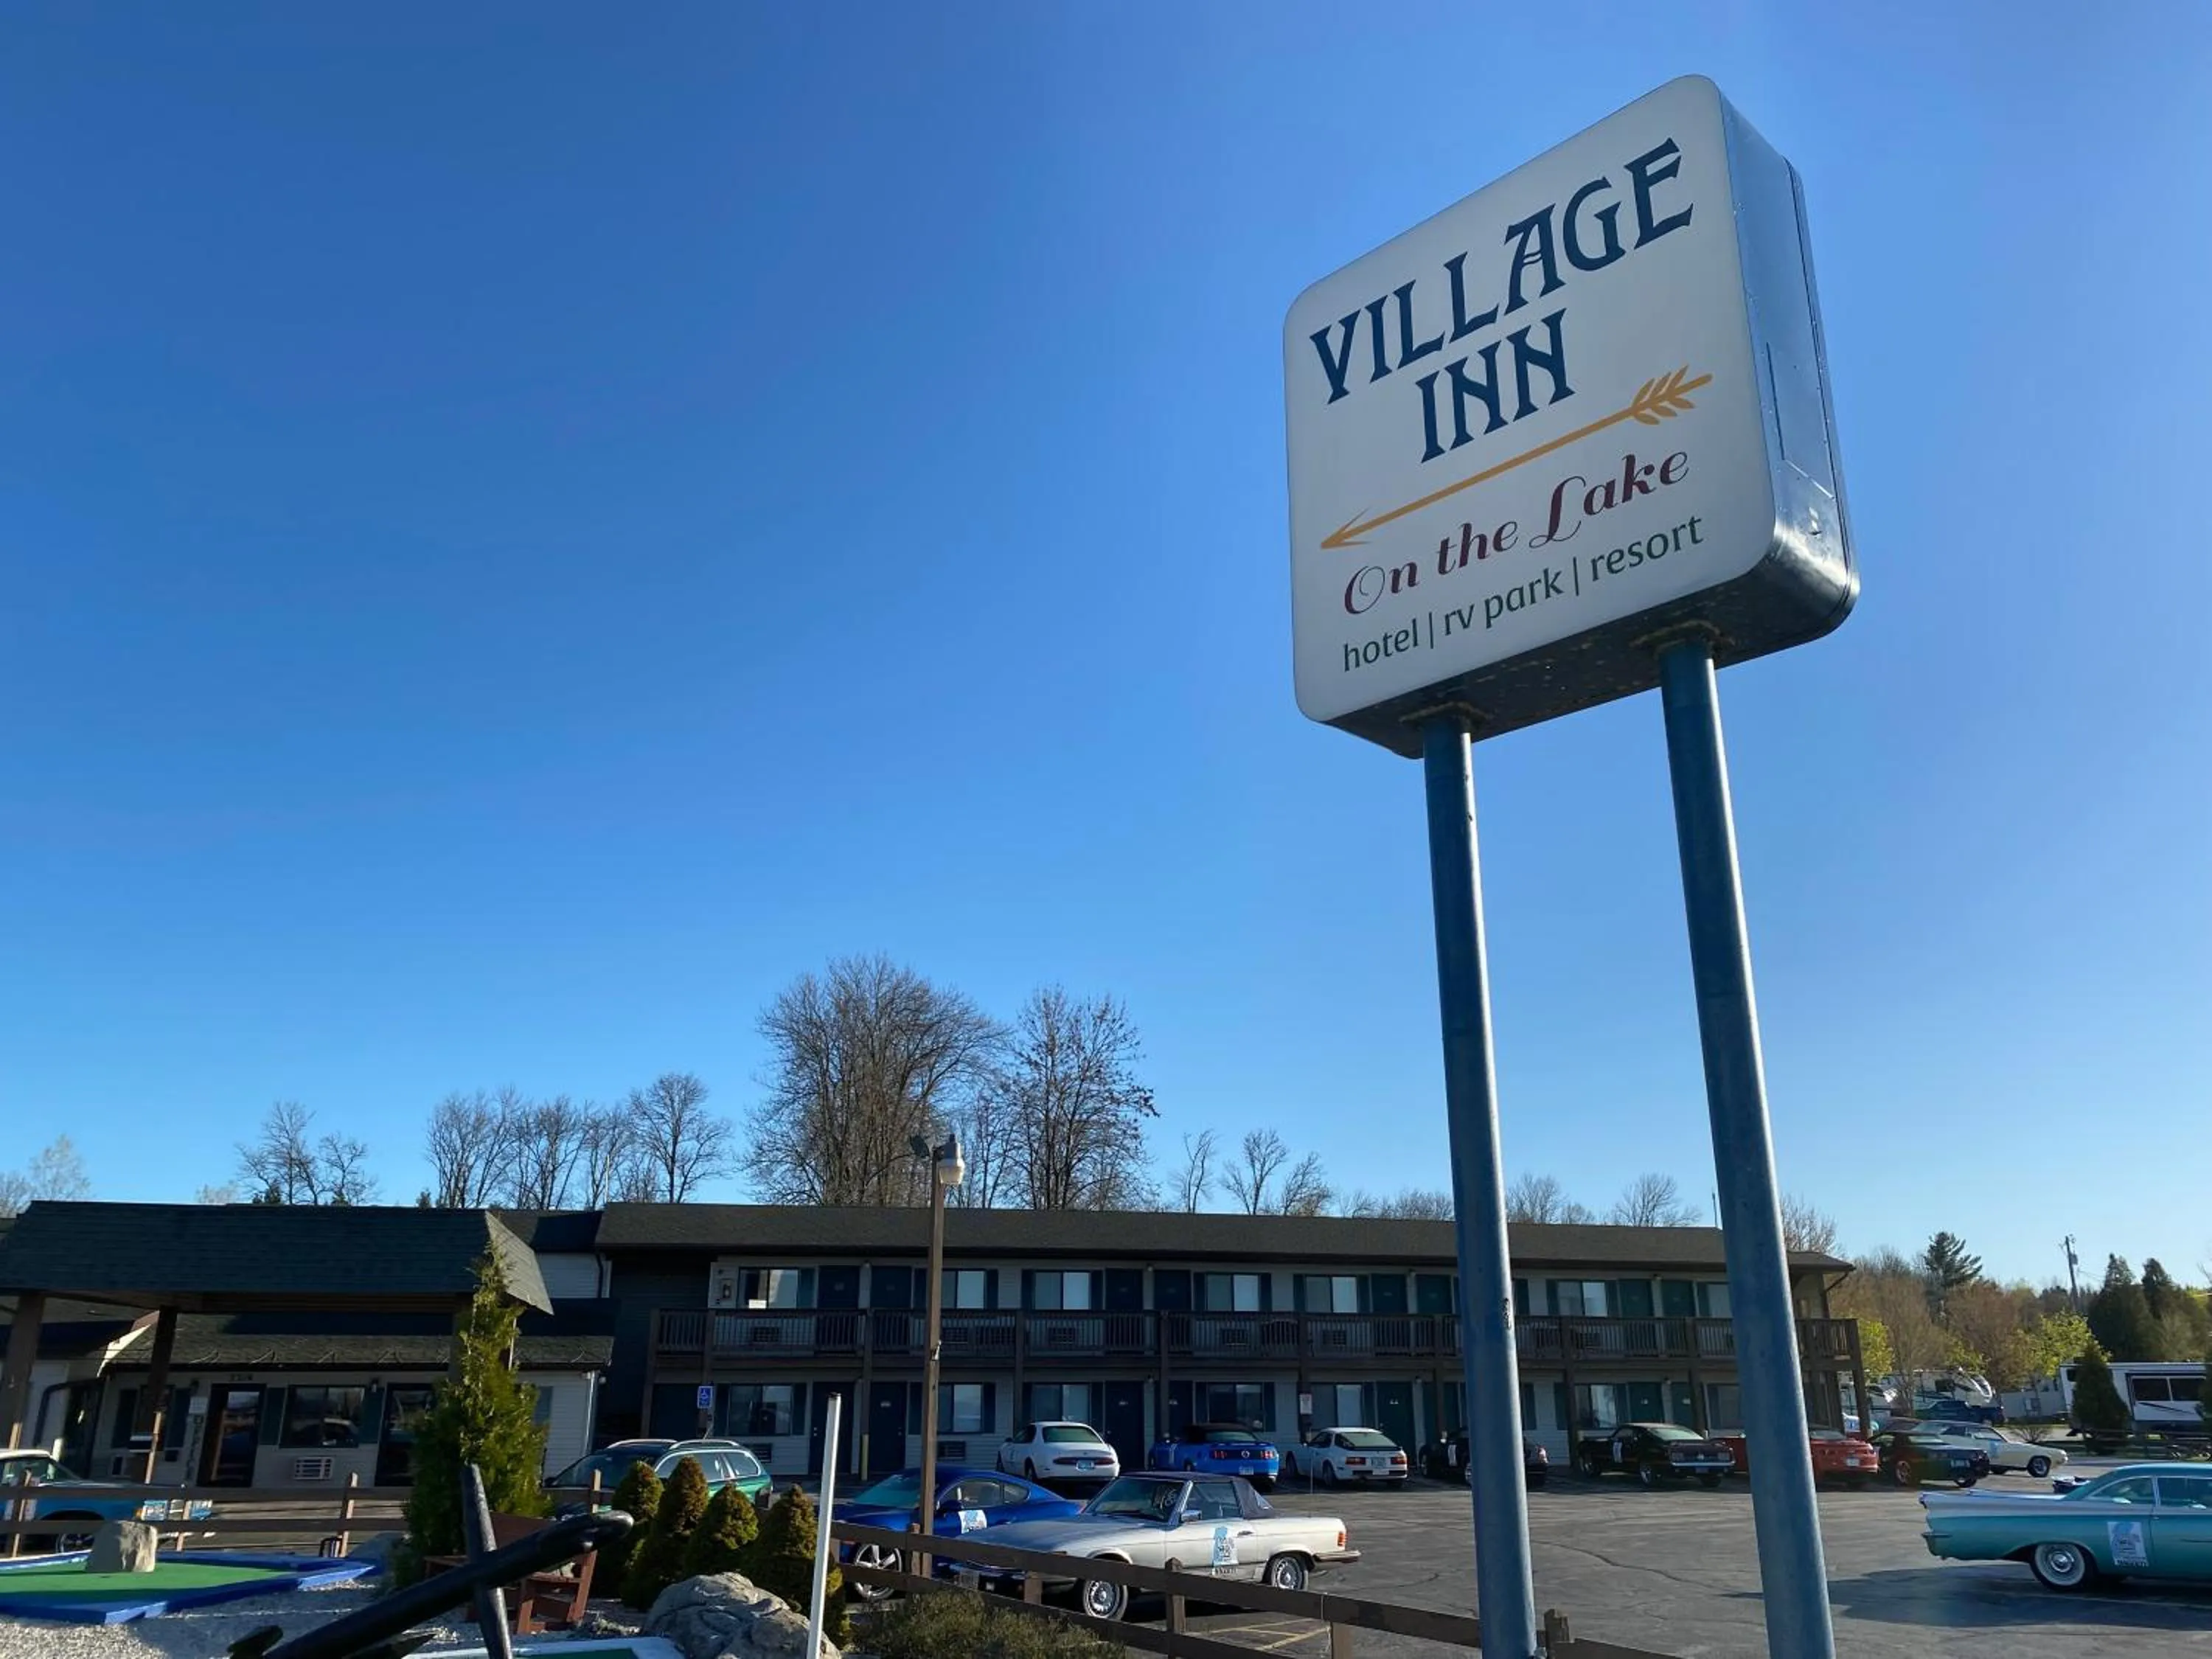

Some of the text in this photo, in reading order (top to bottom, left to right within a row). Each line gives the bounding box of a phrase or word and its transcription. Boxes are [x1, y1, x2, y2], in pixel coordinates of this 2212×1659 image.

[1309, 136, 1694, 406] VILLAGE
[1414, 307, 1576, 465] INN
[1343, 451, 1691, 616] On the Lake
[1343, 617, 1419, 673] hotel
[1444, 603, 1475, 636] rv
[1484, 567, 1565, 630] park
[1590, 515, 1704, 582] resort
